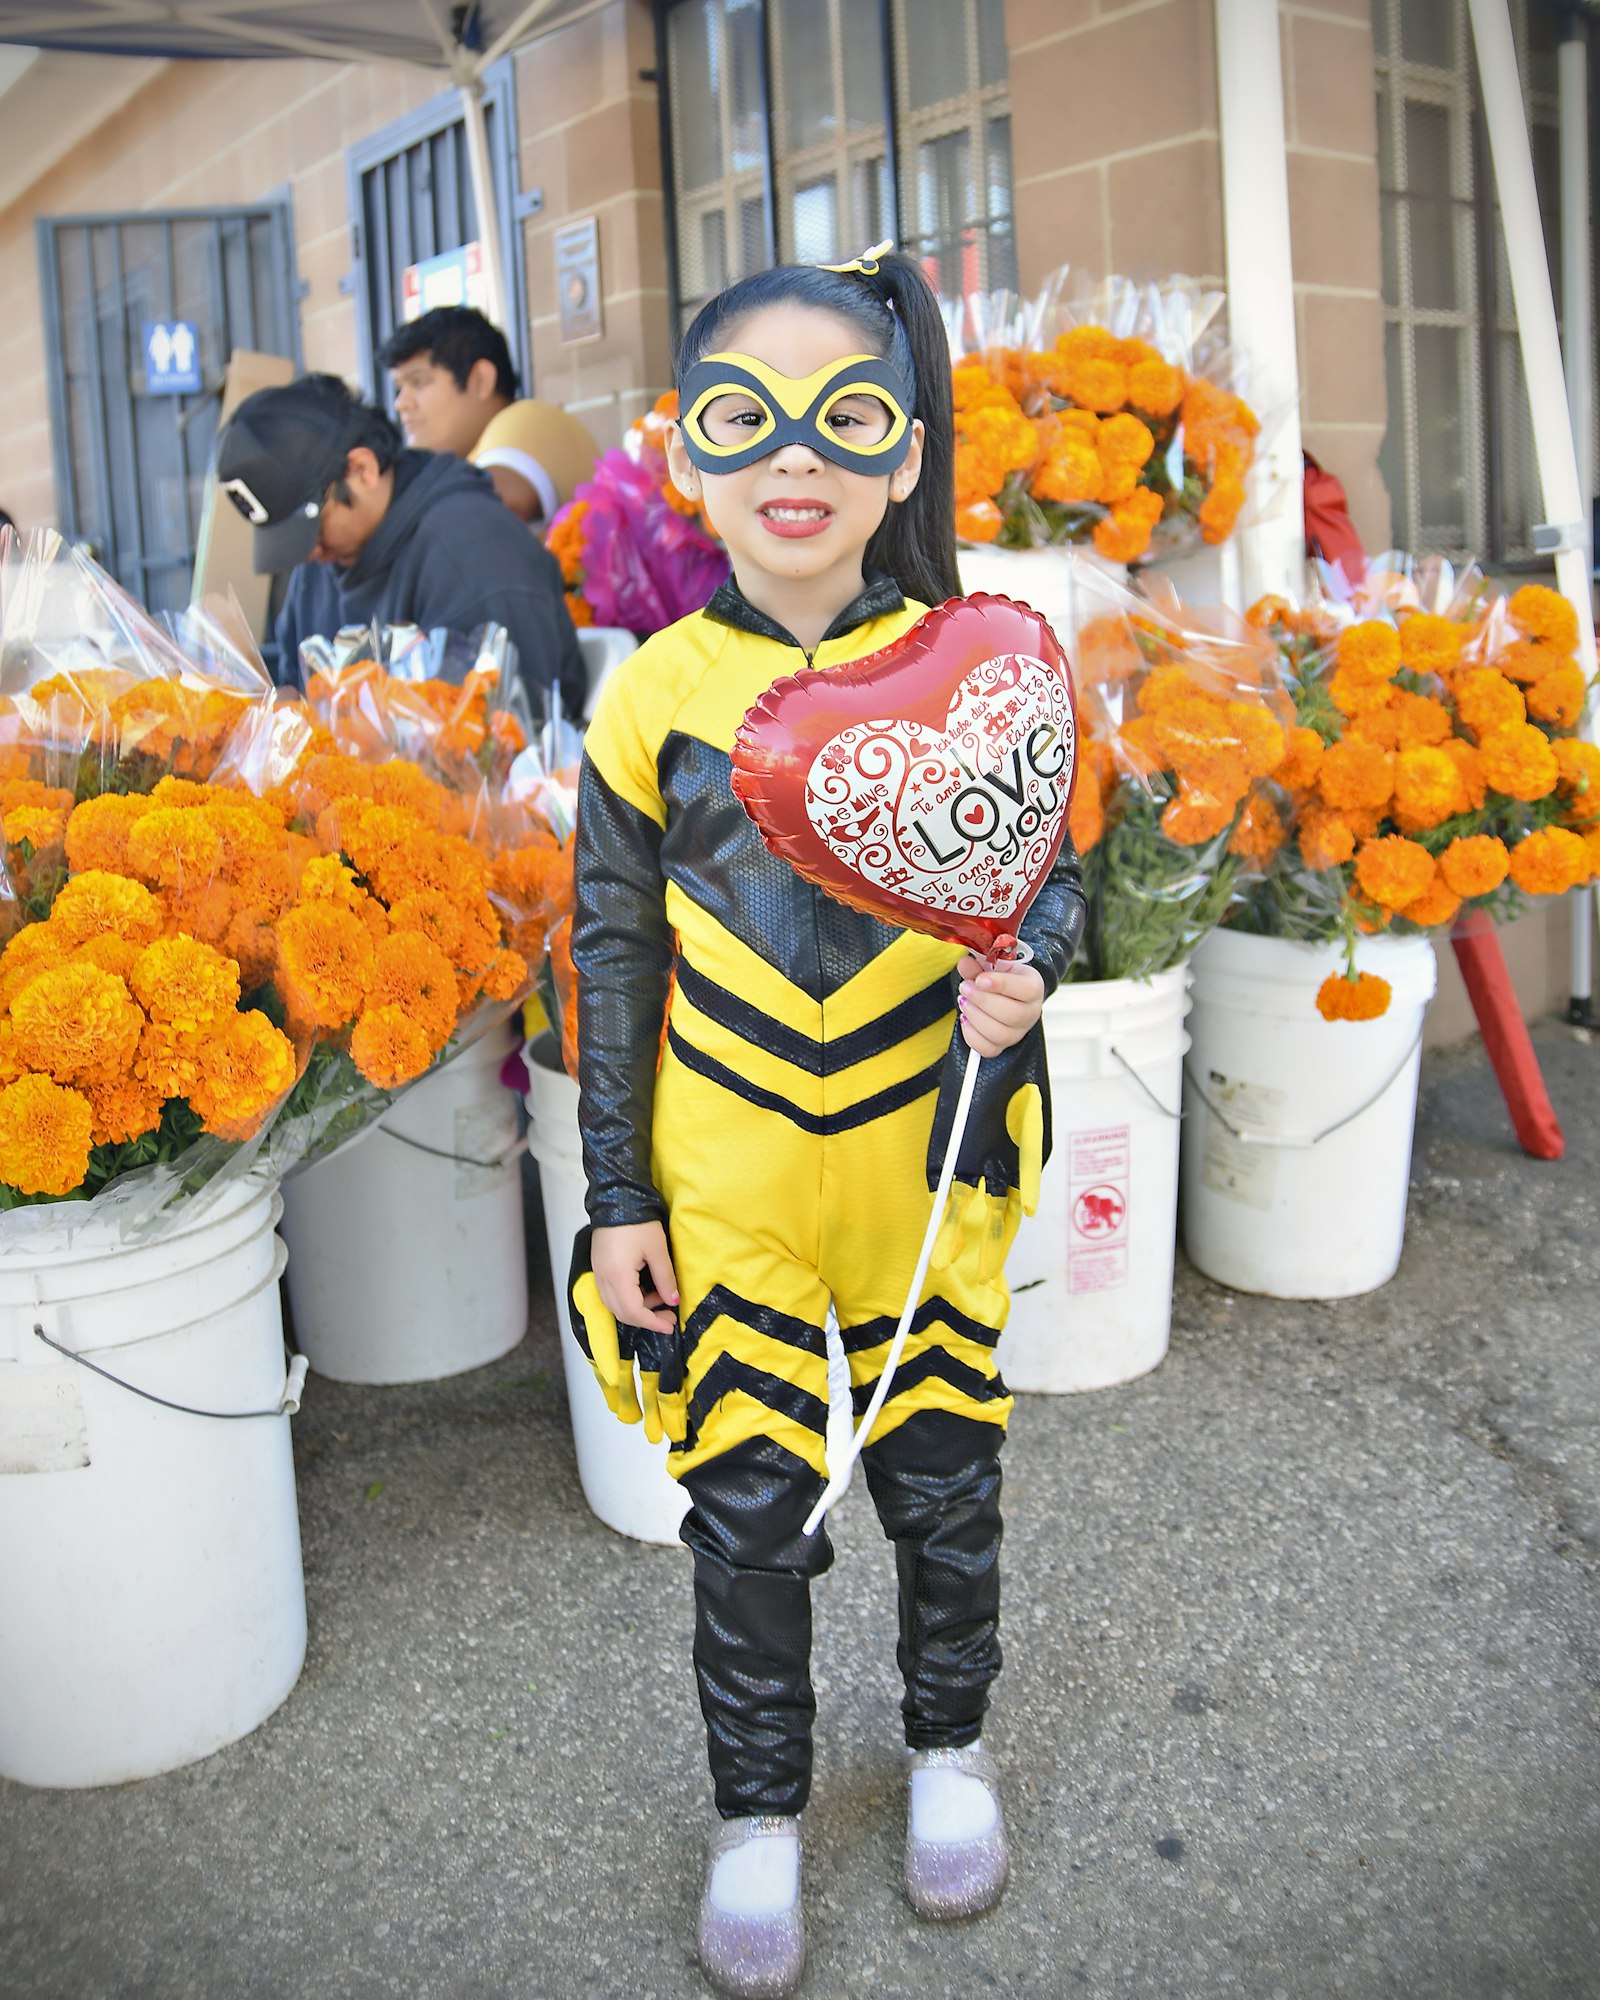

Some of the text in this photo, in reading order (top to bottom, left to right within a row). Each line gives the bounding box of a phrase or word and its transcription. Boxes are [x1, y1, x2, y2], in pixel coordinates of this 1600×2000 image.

[934, 701, 990, 754] Ich liebe dich
[910, 780, 962, 816] Te amo
[987, 780, 1058, 866] you
[921, 854, 995, 897] Te amo
